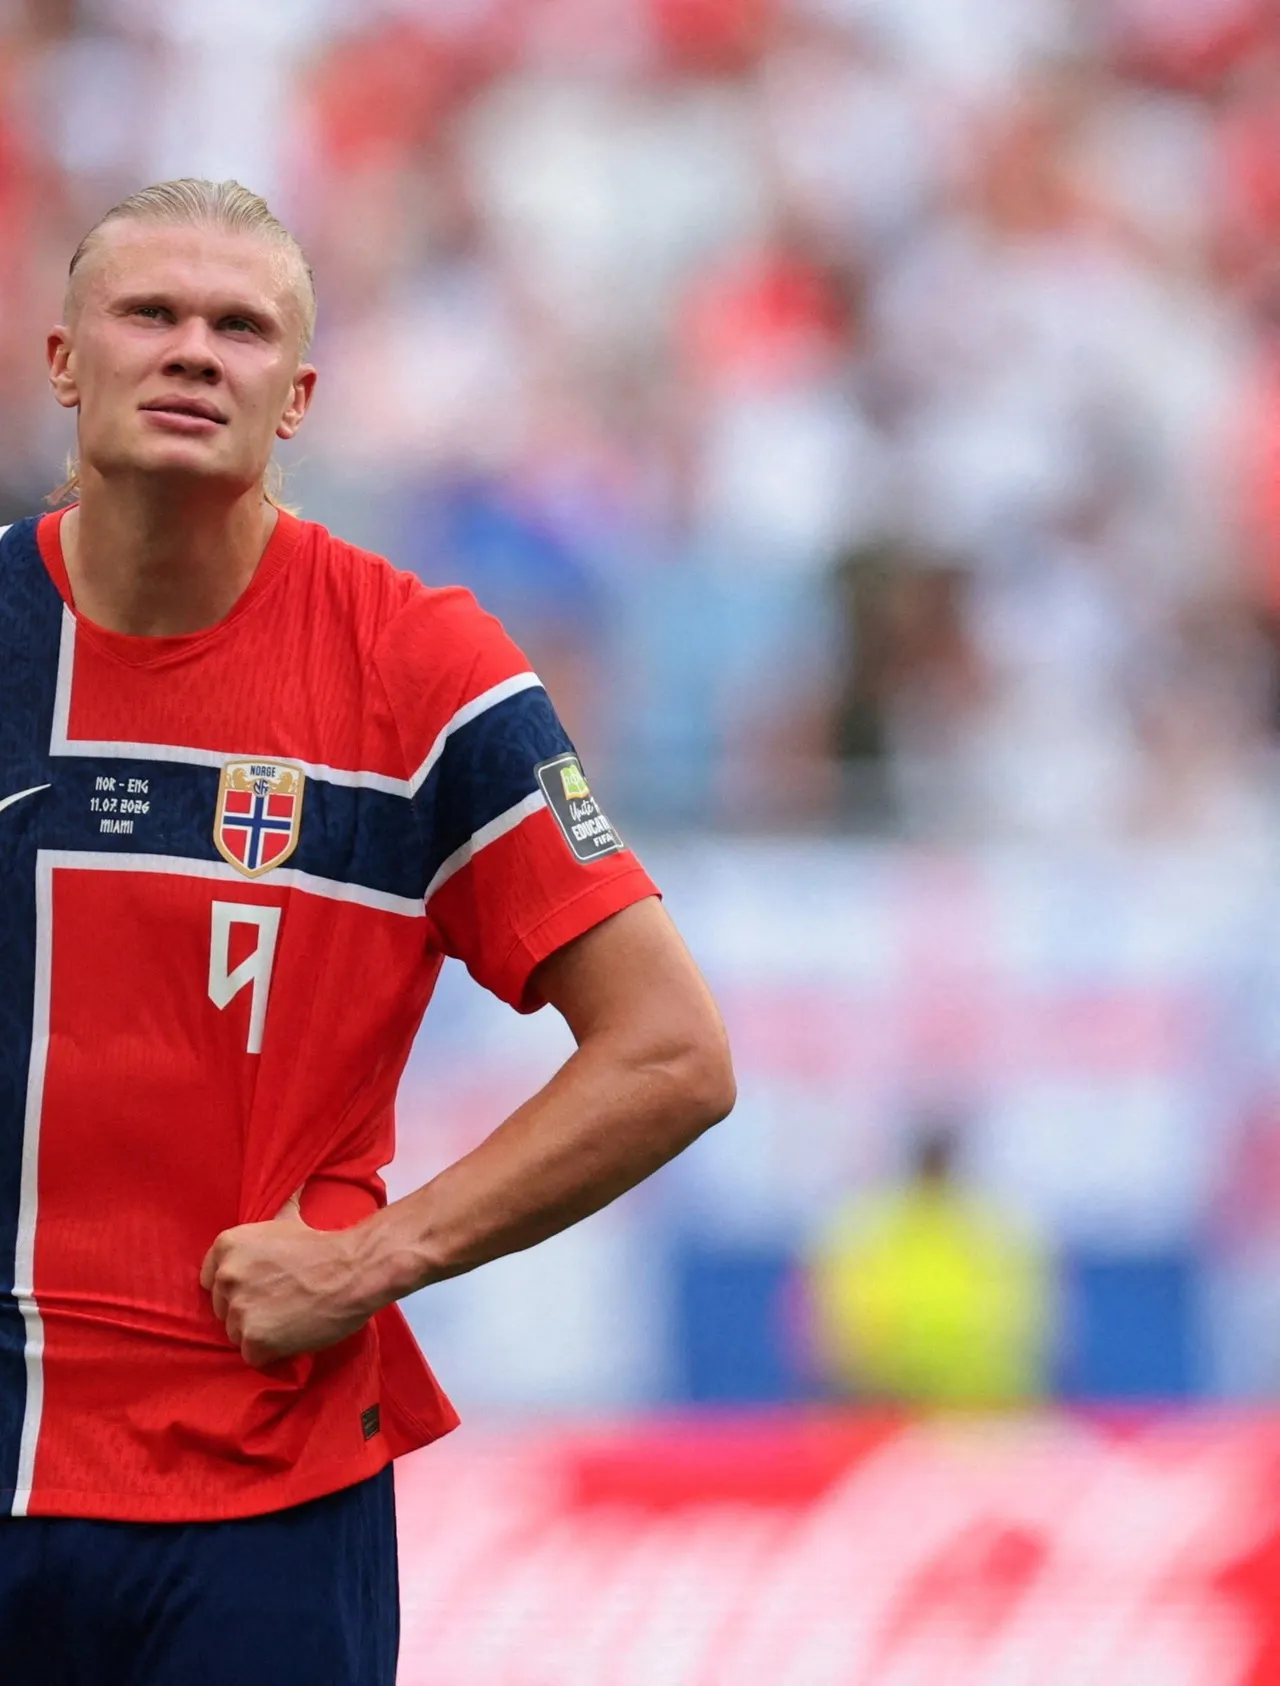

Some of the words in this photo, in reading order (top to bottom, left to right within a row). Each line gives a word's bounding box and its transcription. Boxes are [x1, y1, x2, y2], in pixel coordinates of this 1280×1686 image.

[250, 765, 276, 778] NORGE
[95, 777, 116, 791] NOR
[127, 779, 149, 794] ENG
[100, 819, 134, 834] MIAMI
[593, 833, 614, 847] FIFA
[208, 900, 281, 1054] 9
